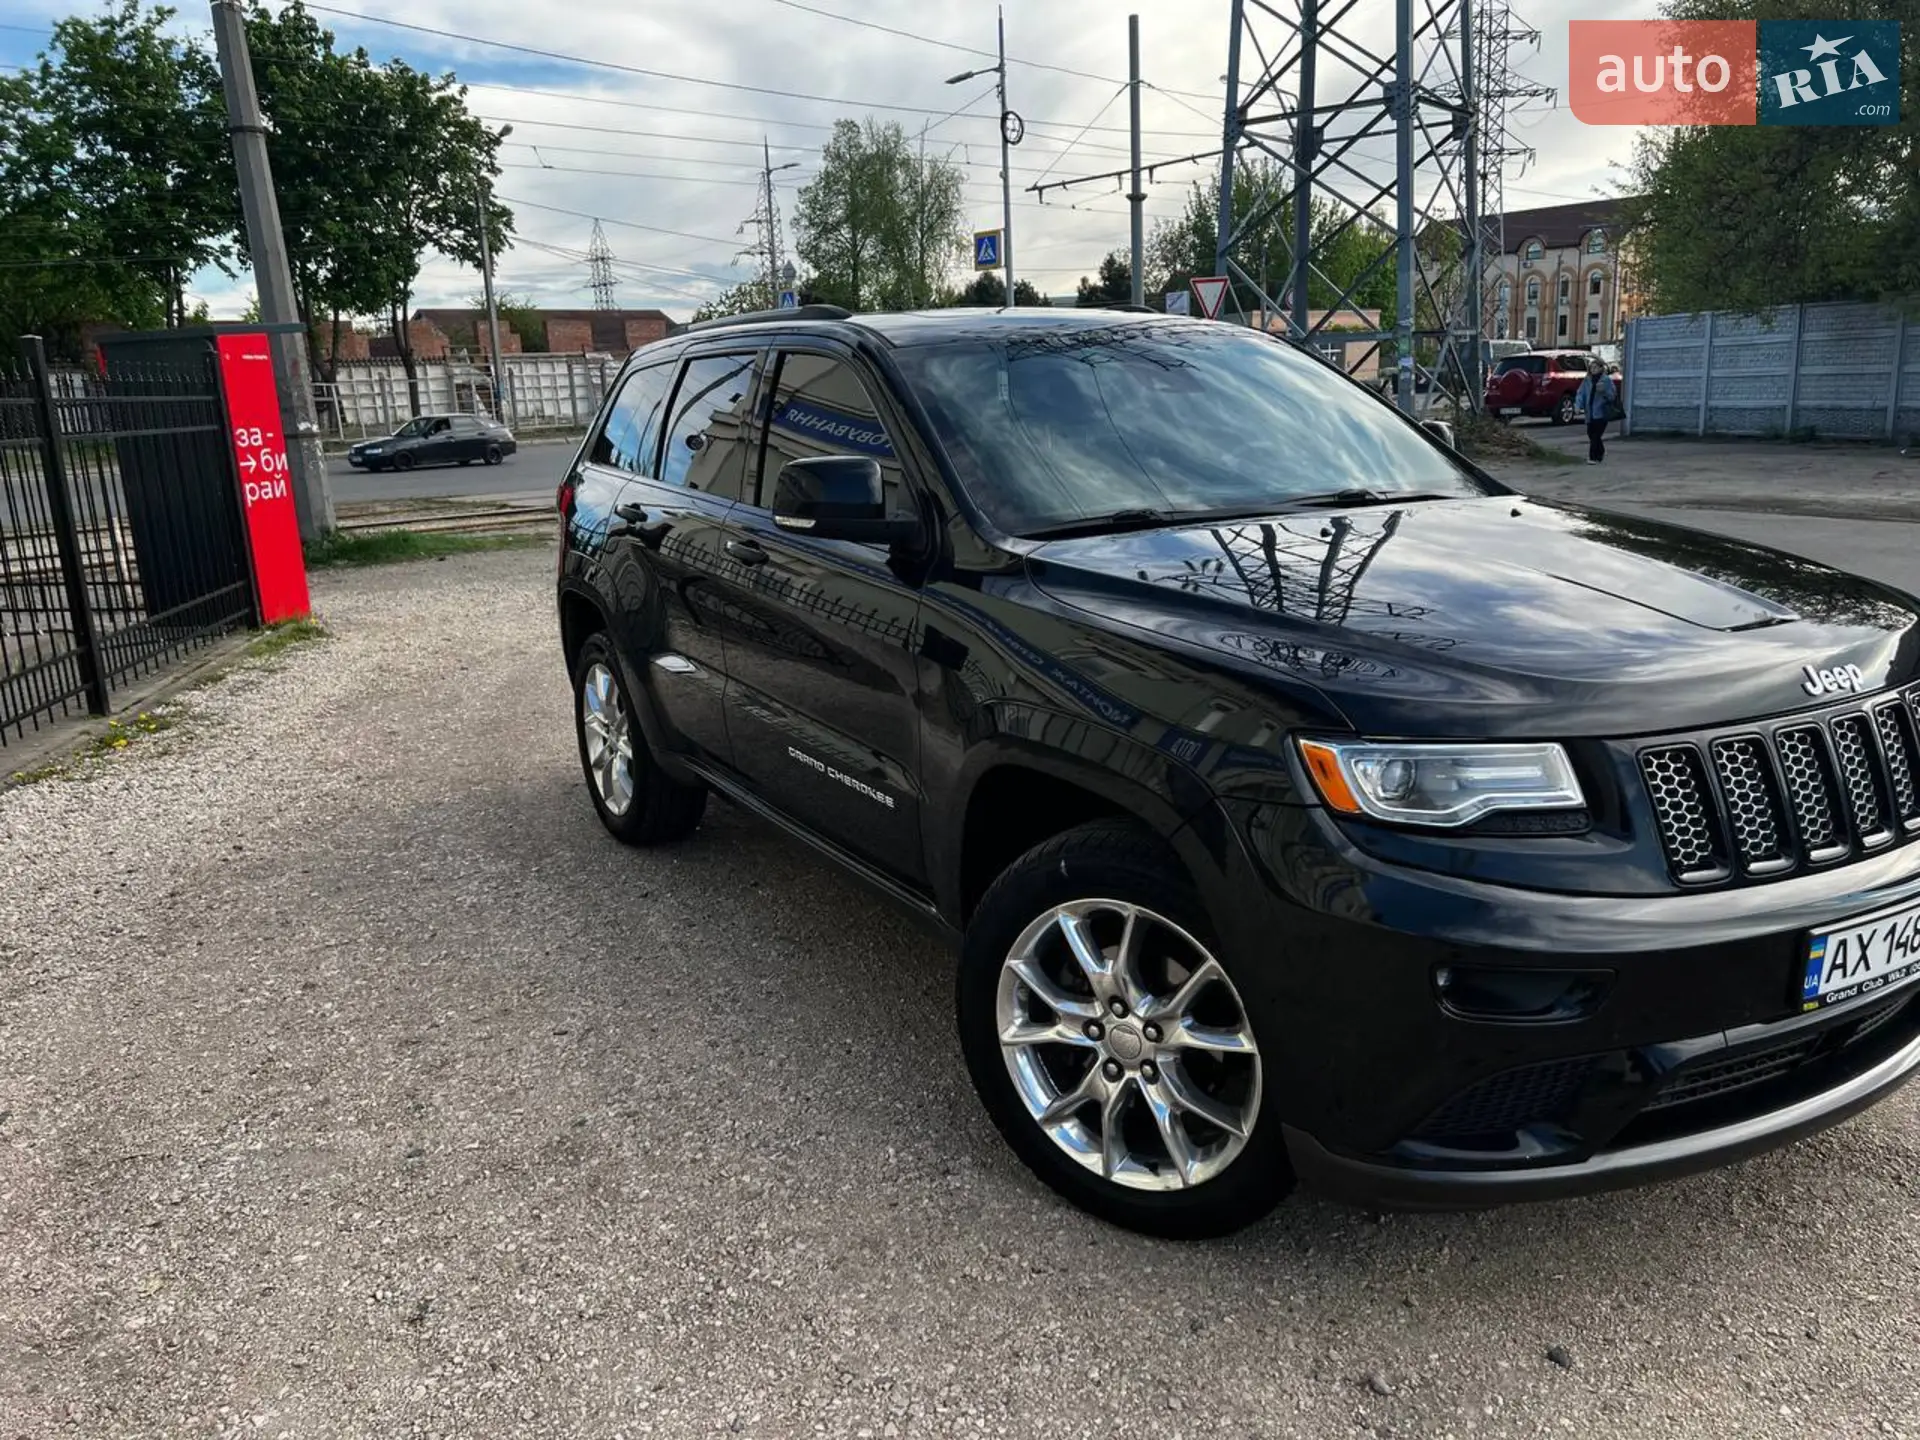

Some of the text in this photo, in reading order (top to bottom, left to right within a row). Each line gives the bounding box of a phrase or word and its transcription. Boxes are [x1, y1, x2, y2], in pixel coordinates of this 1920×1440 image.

[236, 427, 274, 447] за-
[261, 448, 289, 473] би
[245, 474, 287, 507] рай
[1804, 663, 1865, 696] Jeep
[788, 746, 895, 808] GRAND CHEROKEE
[1825, 928, 1877, 983] AX
[1804, 974, 1819, 989] UA
[1826, 986, 1858, 1003] Grand
[1862, 977, 1884, 992] Club
